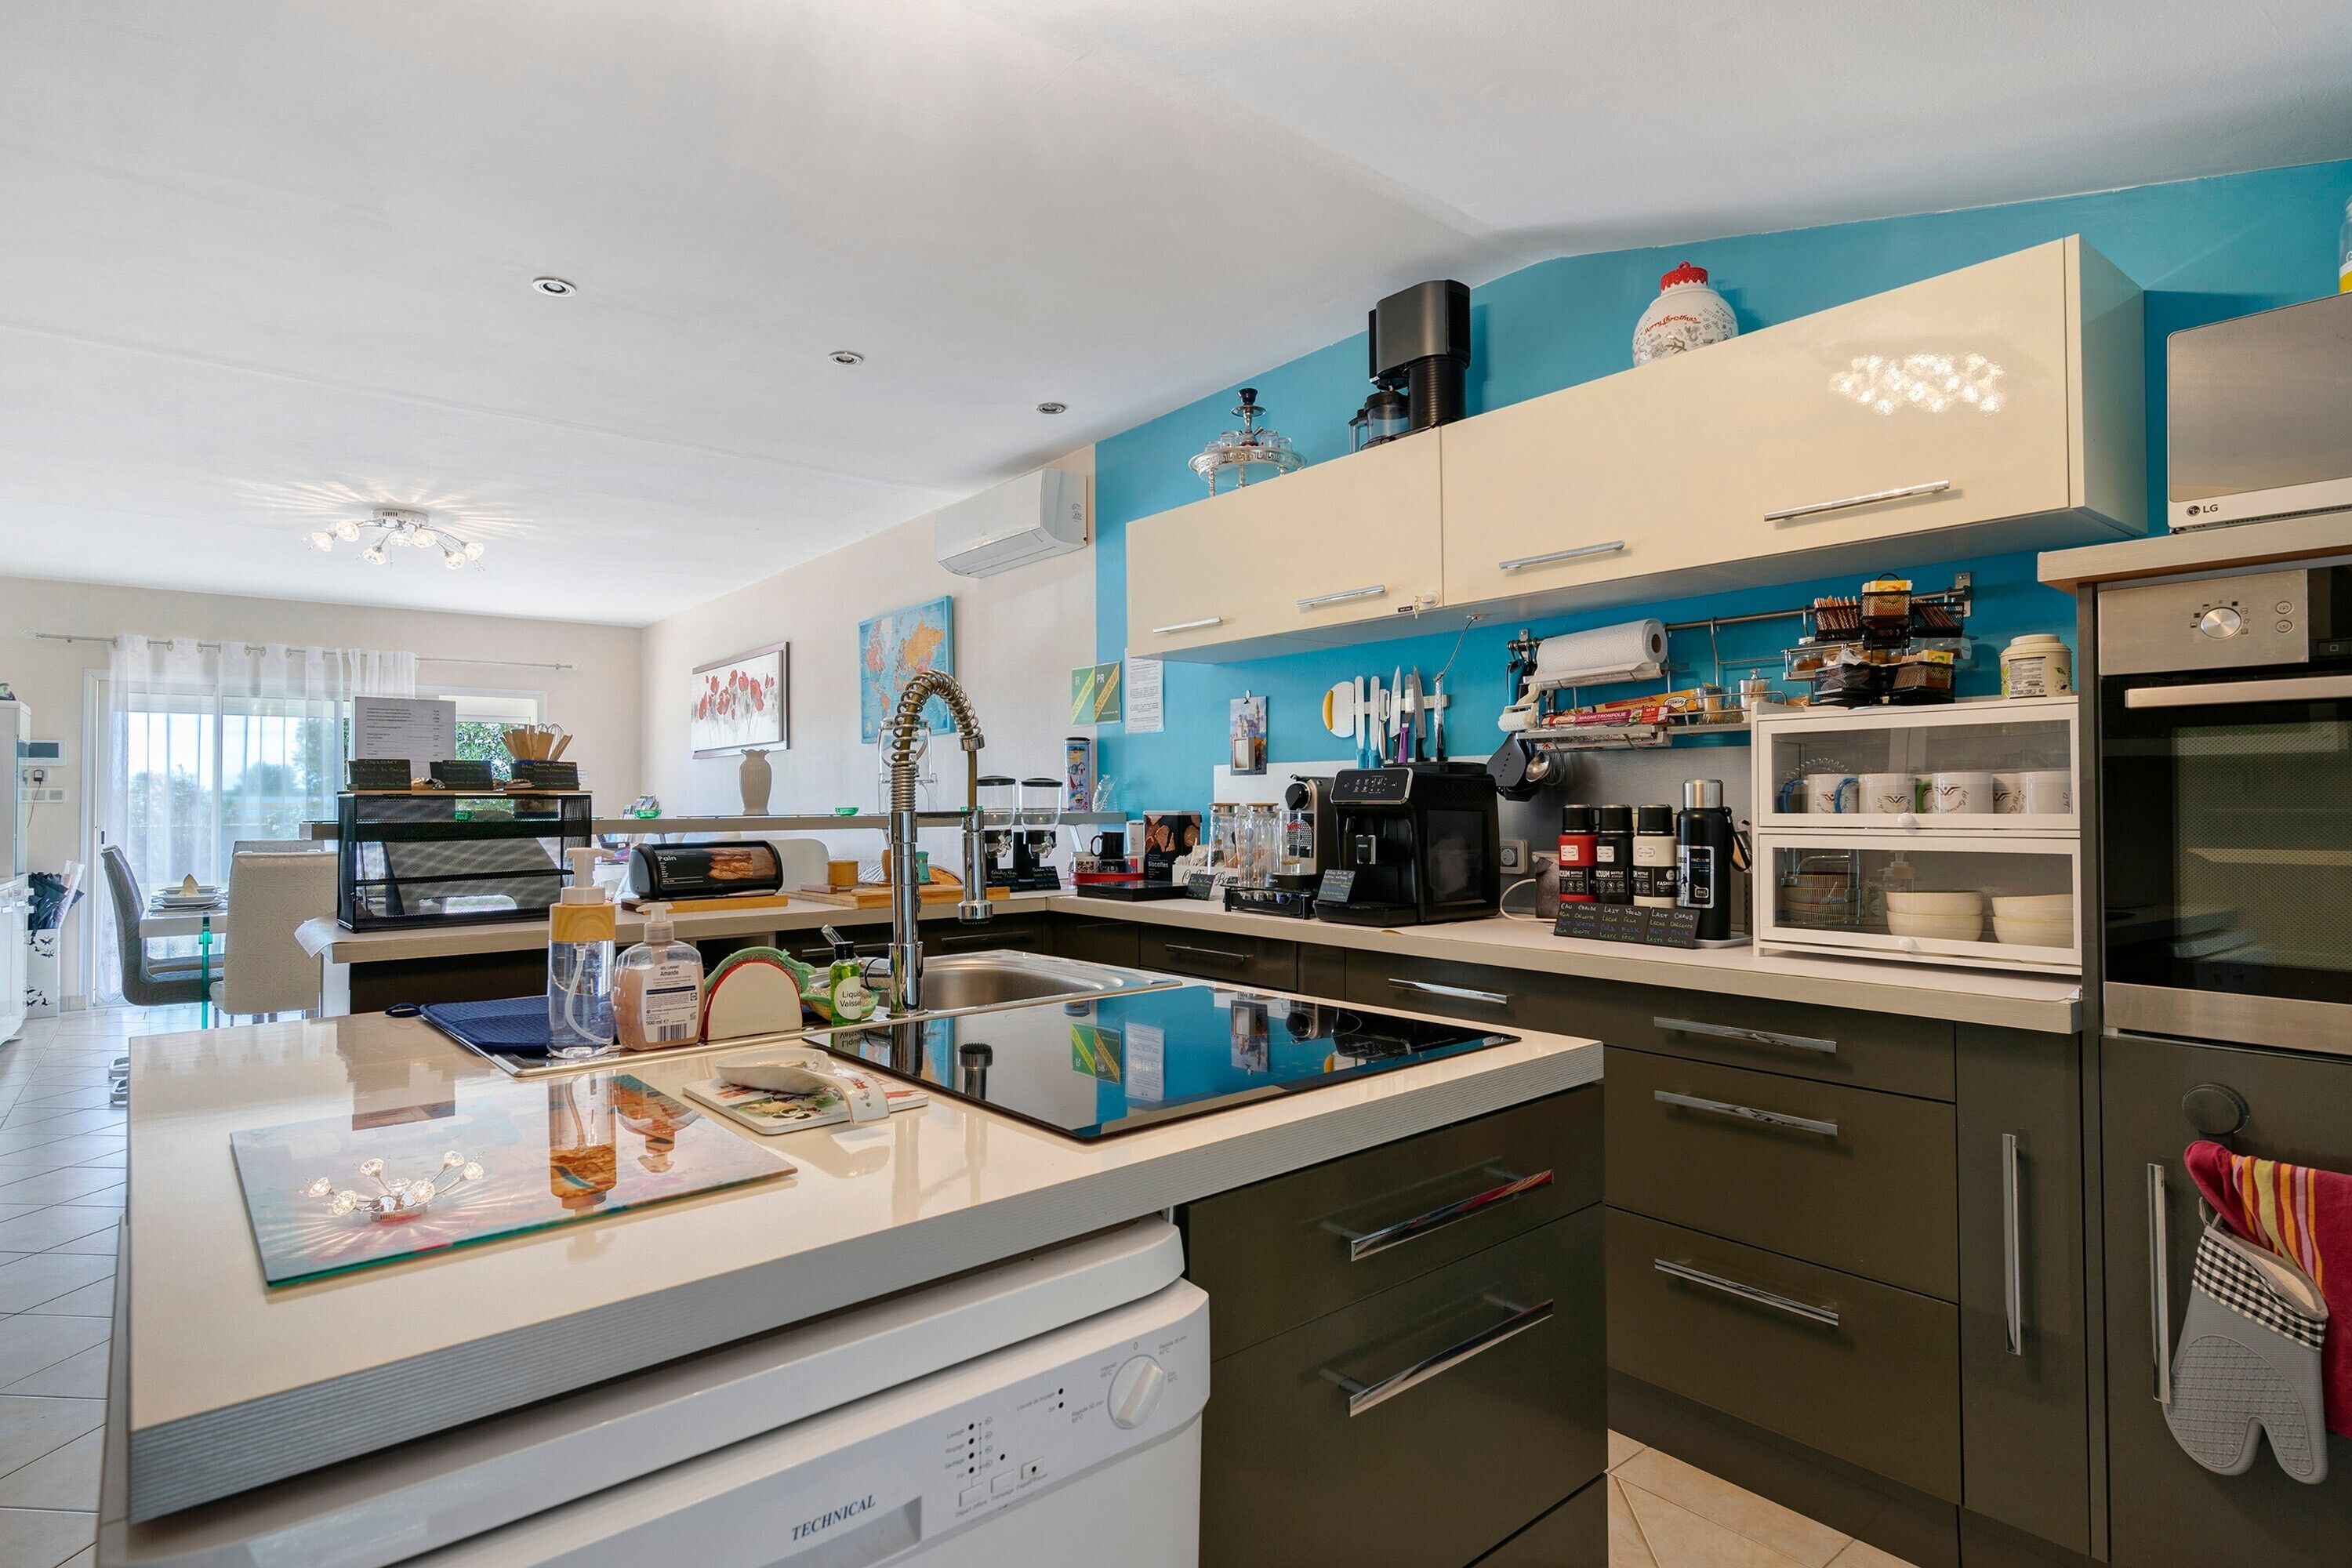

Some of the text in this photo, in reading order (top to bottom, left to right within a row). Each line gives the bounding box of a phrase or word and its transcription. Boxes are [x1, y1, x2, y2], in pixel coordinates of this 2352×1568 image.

[1661, 314, 1699, 325] Christmas
[2202, 503, 2219, 514] LG
[1096, 673, 1105, 684] PR
[1578, 711, 1627, 720] MAGNETRONFOLIE
[791, 1494, 877, 1541] TECHNICAL
